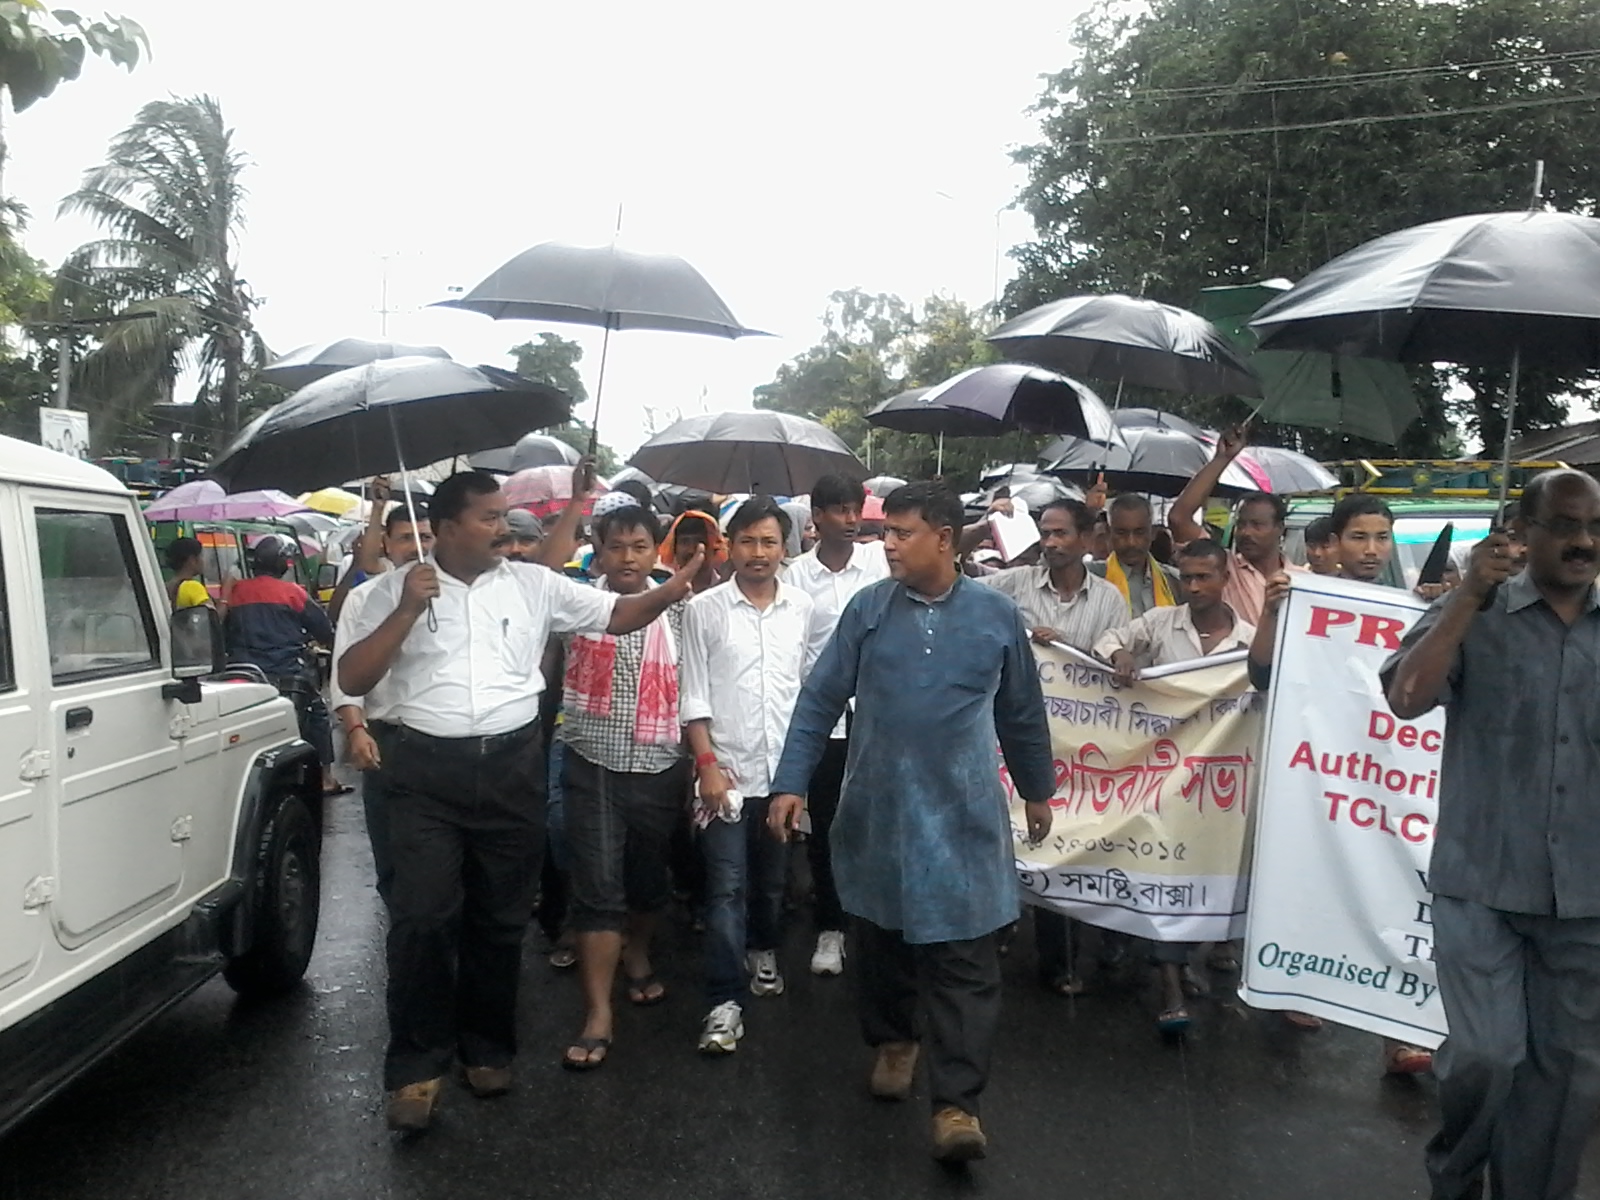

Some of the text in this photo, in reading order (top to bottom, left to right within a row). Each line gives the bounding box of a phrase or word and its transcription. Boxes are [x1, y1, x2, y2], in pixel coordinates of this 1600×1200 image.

[1368, 710, 1442, 752] Dec
[1289, 741, 1438, 799] Authori
[1324, 791, 1438, 843] TCLC
[1258, 942, 1437, 1007] Organised By
